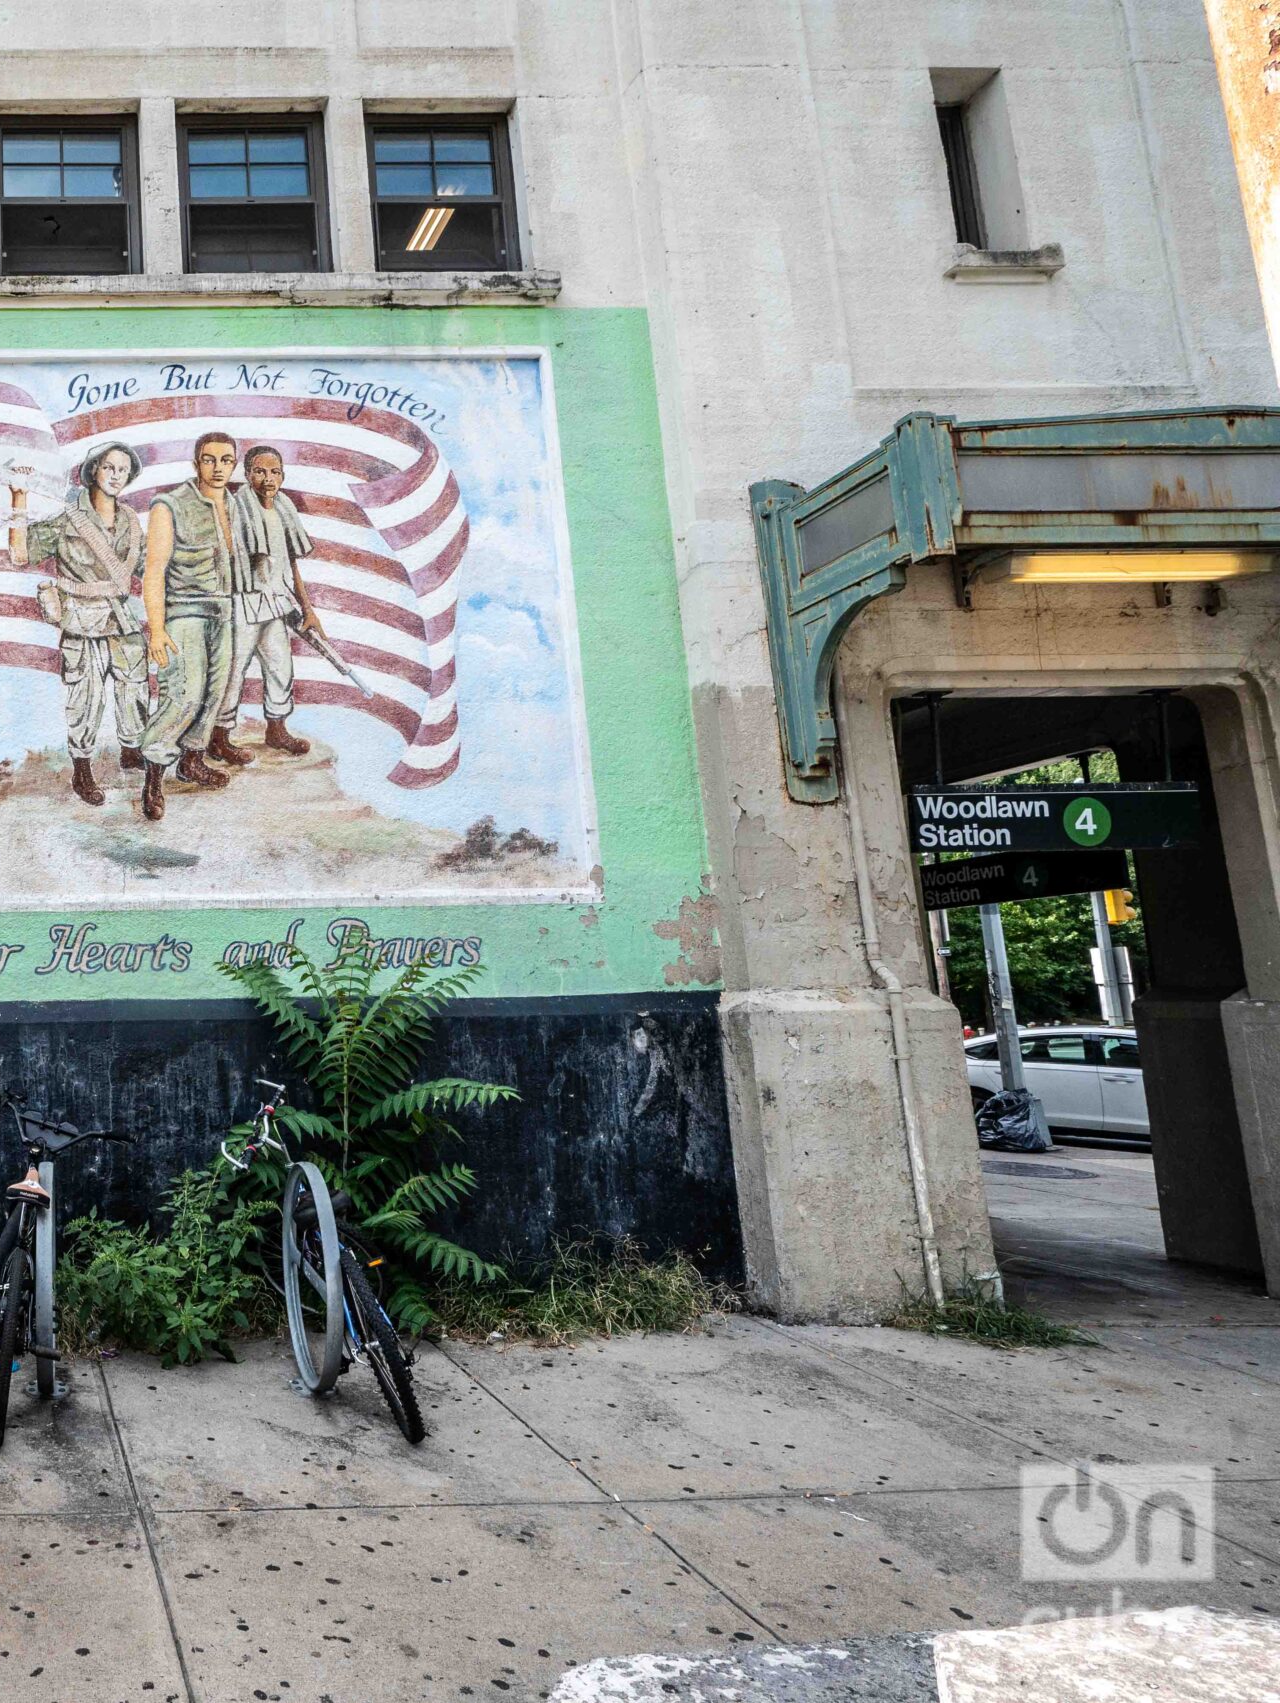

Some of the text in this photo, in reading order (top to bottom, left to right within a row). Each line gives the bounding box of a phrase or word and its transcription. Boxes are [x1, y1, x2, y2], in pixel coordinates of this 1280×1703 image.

[67, 363, 449, 435] Gone But Not Forgotten
[916, 796, 1050, 820] Woodlawn
[1074, 807, 1098, 836] 4
[919, 823, 1012, 848] Station
[922, 861, 1005, 888] Woodlawn
[1022, 865, 1039, 887] 4
[924, 887, 981, 908] Station
[34, 922, 193, 974] Hearts
[222, 918, 305, 970] and
[325, 916, 483, 988] Prayers
